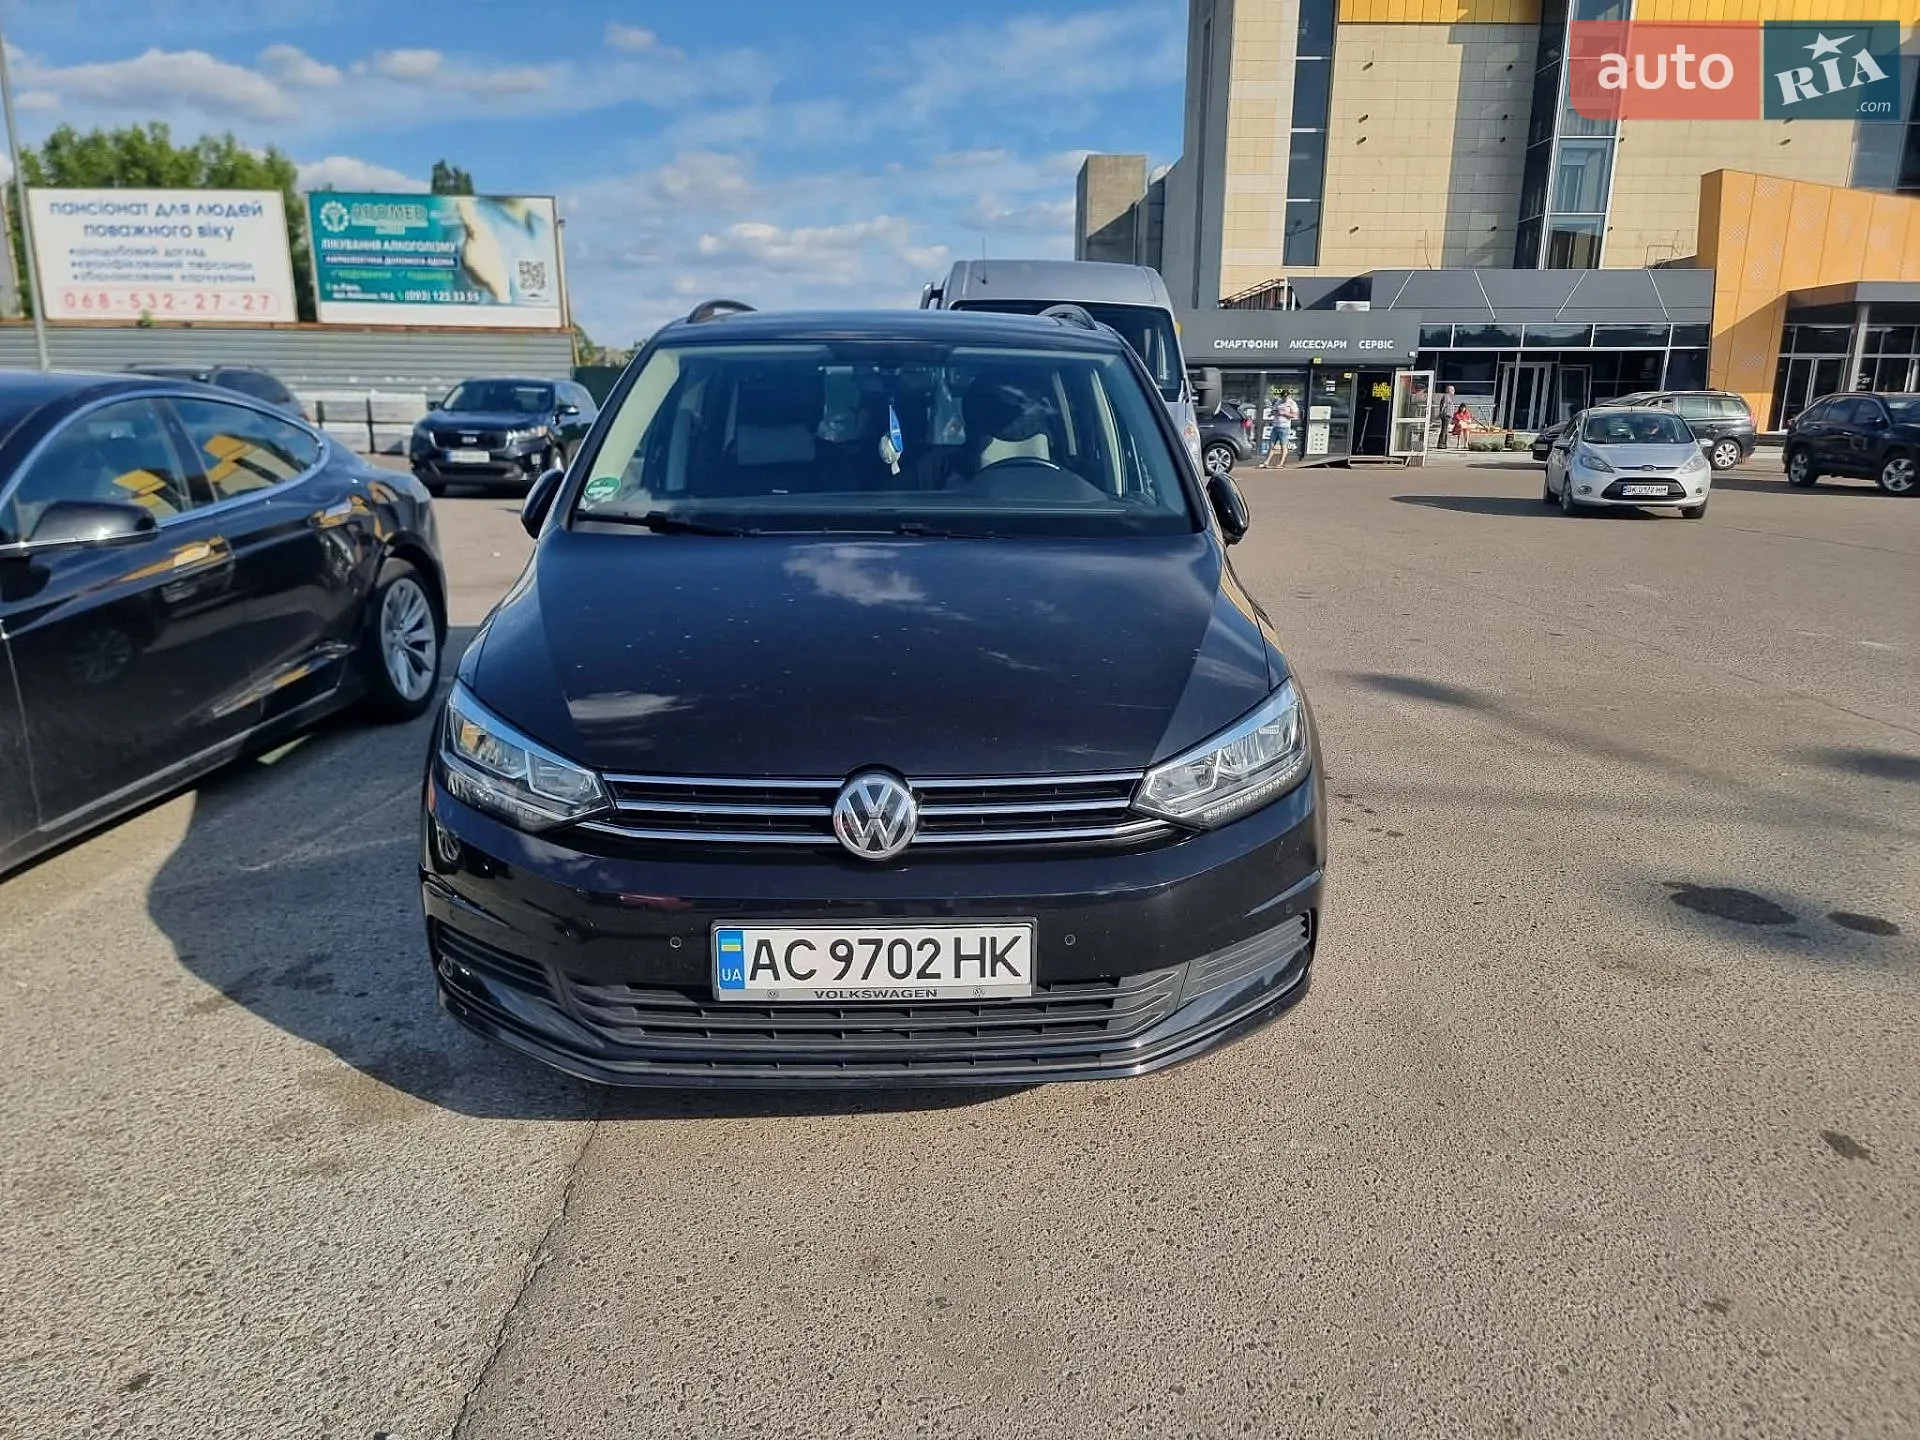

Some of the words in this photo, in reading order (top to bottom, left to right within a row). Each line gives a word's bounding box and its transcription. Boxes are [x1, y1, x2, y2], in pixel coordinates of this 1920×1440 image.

[155, 202, 190, 218] для
[196, 201, 264, 218] людей
[83, 223, 192, 238] поважного
[198, 223, 235, 241] віку
[1213, 339, 1279, 349] СМАРТФОНИ
[1289, 339, 1348, 350] АКСЕСУАРИ
[1358, 339, 1395, 349] СЕРВІС
[749, 938, 817, 981] AC
[828, 937, 942, 981] 9702
[953, 934, 1022, 979] HK
[721, 967, 742, 981] UA
[814, 988, 938, 999] VOLKSWAGEN
